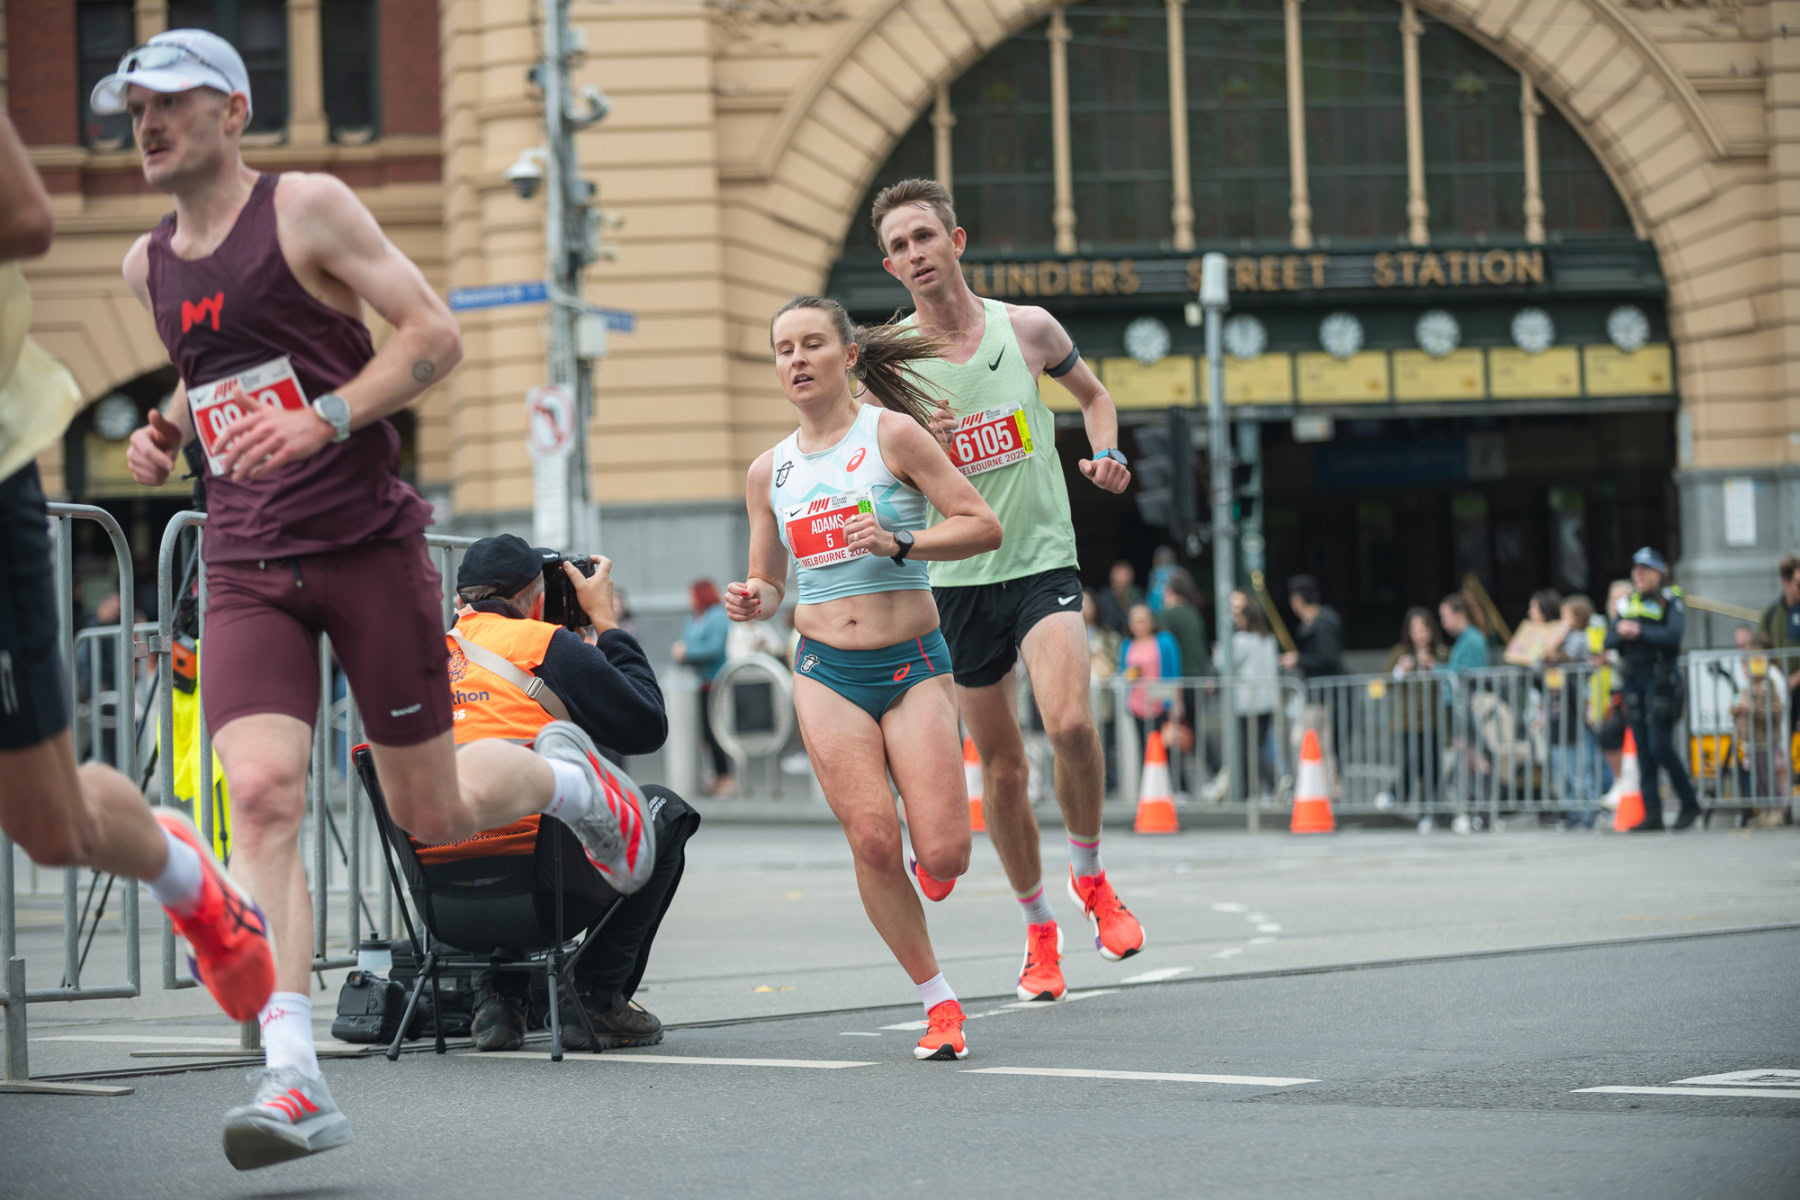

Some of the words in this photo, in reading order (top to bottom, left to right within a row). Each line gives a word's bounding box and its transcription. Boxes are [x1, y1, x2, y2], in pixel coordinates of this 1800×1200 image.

[962, 258, 1140, 297] LINDERS
[1187, 254, 1329, 291] SREET
[1373, 249, 1545, 287] STATION
[955, 420, 1014, 463] 6105
[1004, 449, 1026, 463] 2025
[811, 513, 845, 535] ADAMS
[826, 533, 834, 548] 5
[802, 549, 847, 568] MELBOURNE
[849, 546, 871, 557] 202
